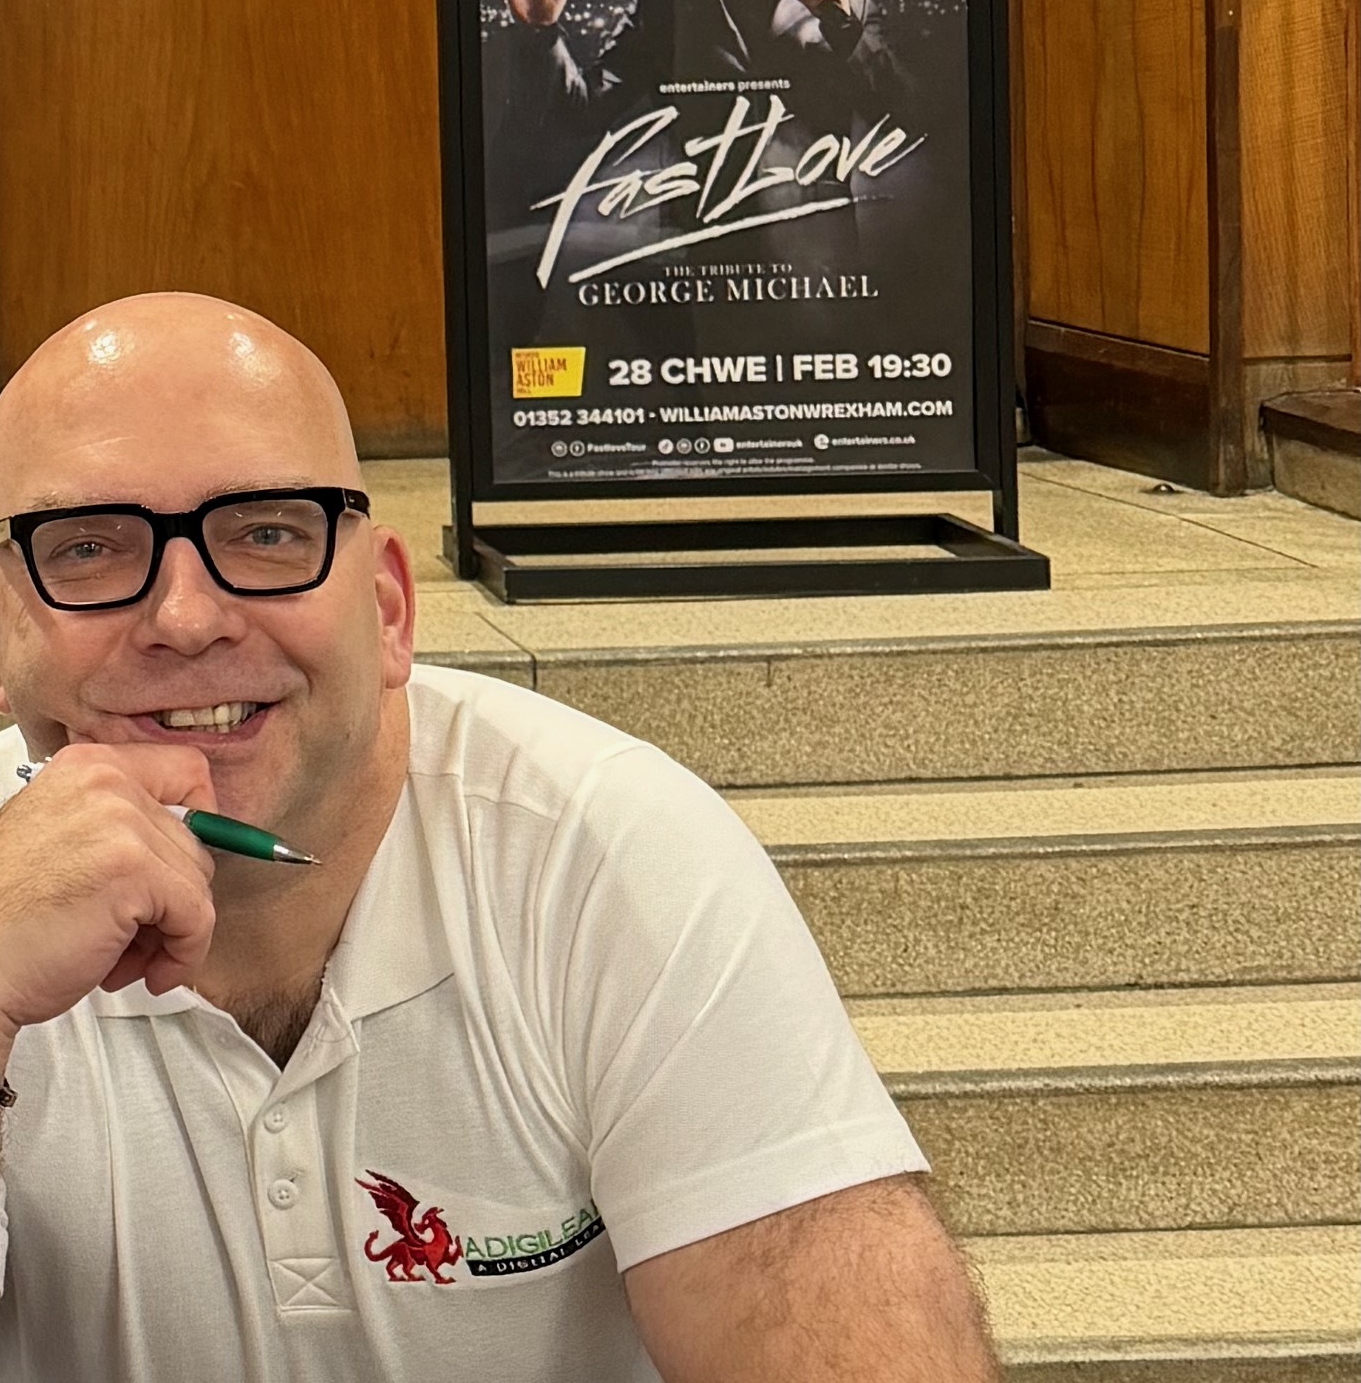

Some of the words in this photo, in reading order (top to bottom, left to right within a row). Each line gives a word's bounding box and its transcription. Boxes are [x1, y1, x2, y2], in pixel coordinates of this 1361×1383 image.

[660, 79, 735, 93] entertainers
[738, 79, 790, 92] presents
[665, 267, 694, 276] THE
[702, 264, 765, 276] TRIBUTE
[772, 264, 792, 274] TO
[579, 279, 715, 306] GEORGE
[727, 275, 878, 301] MICHAEL
[517, 358, 567, 373] WILLIAM
[608, 359, 652, 386] 28
[661, 357, 767, 384] CHWE
[793, 353, 859, 380] FEB
[868, 353, 952, 379] 19:30
[517, 373, 554, 387] ASTON
[513, 410, 572, 426] 01352
[577, 408, 644, 425] 344101
[659, 400, 953, 422] WILLIAMASTONWREXHAM.COM
[479, 1262, 487, 1272] A
